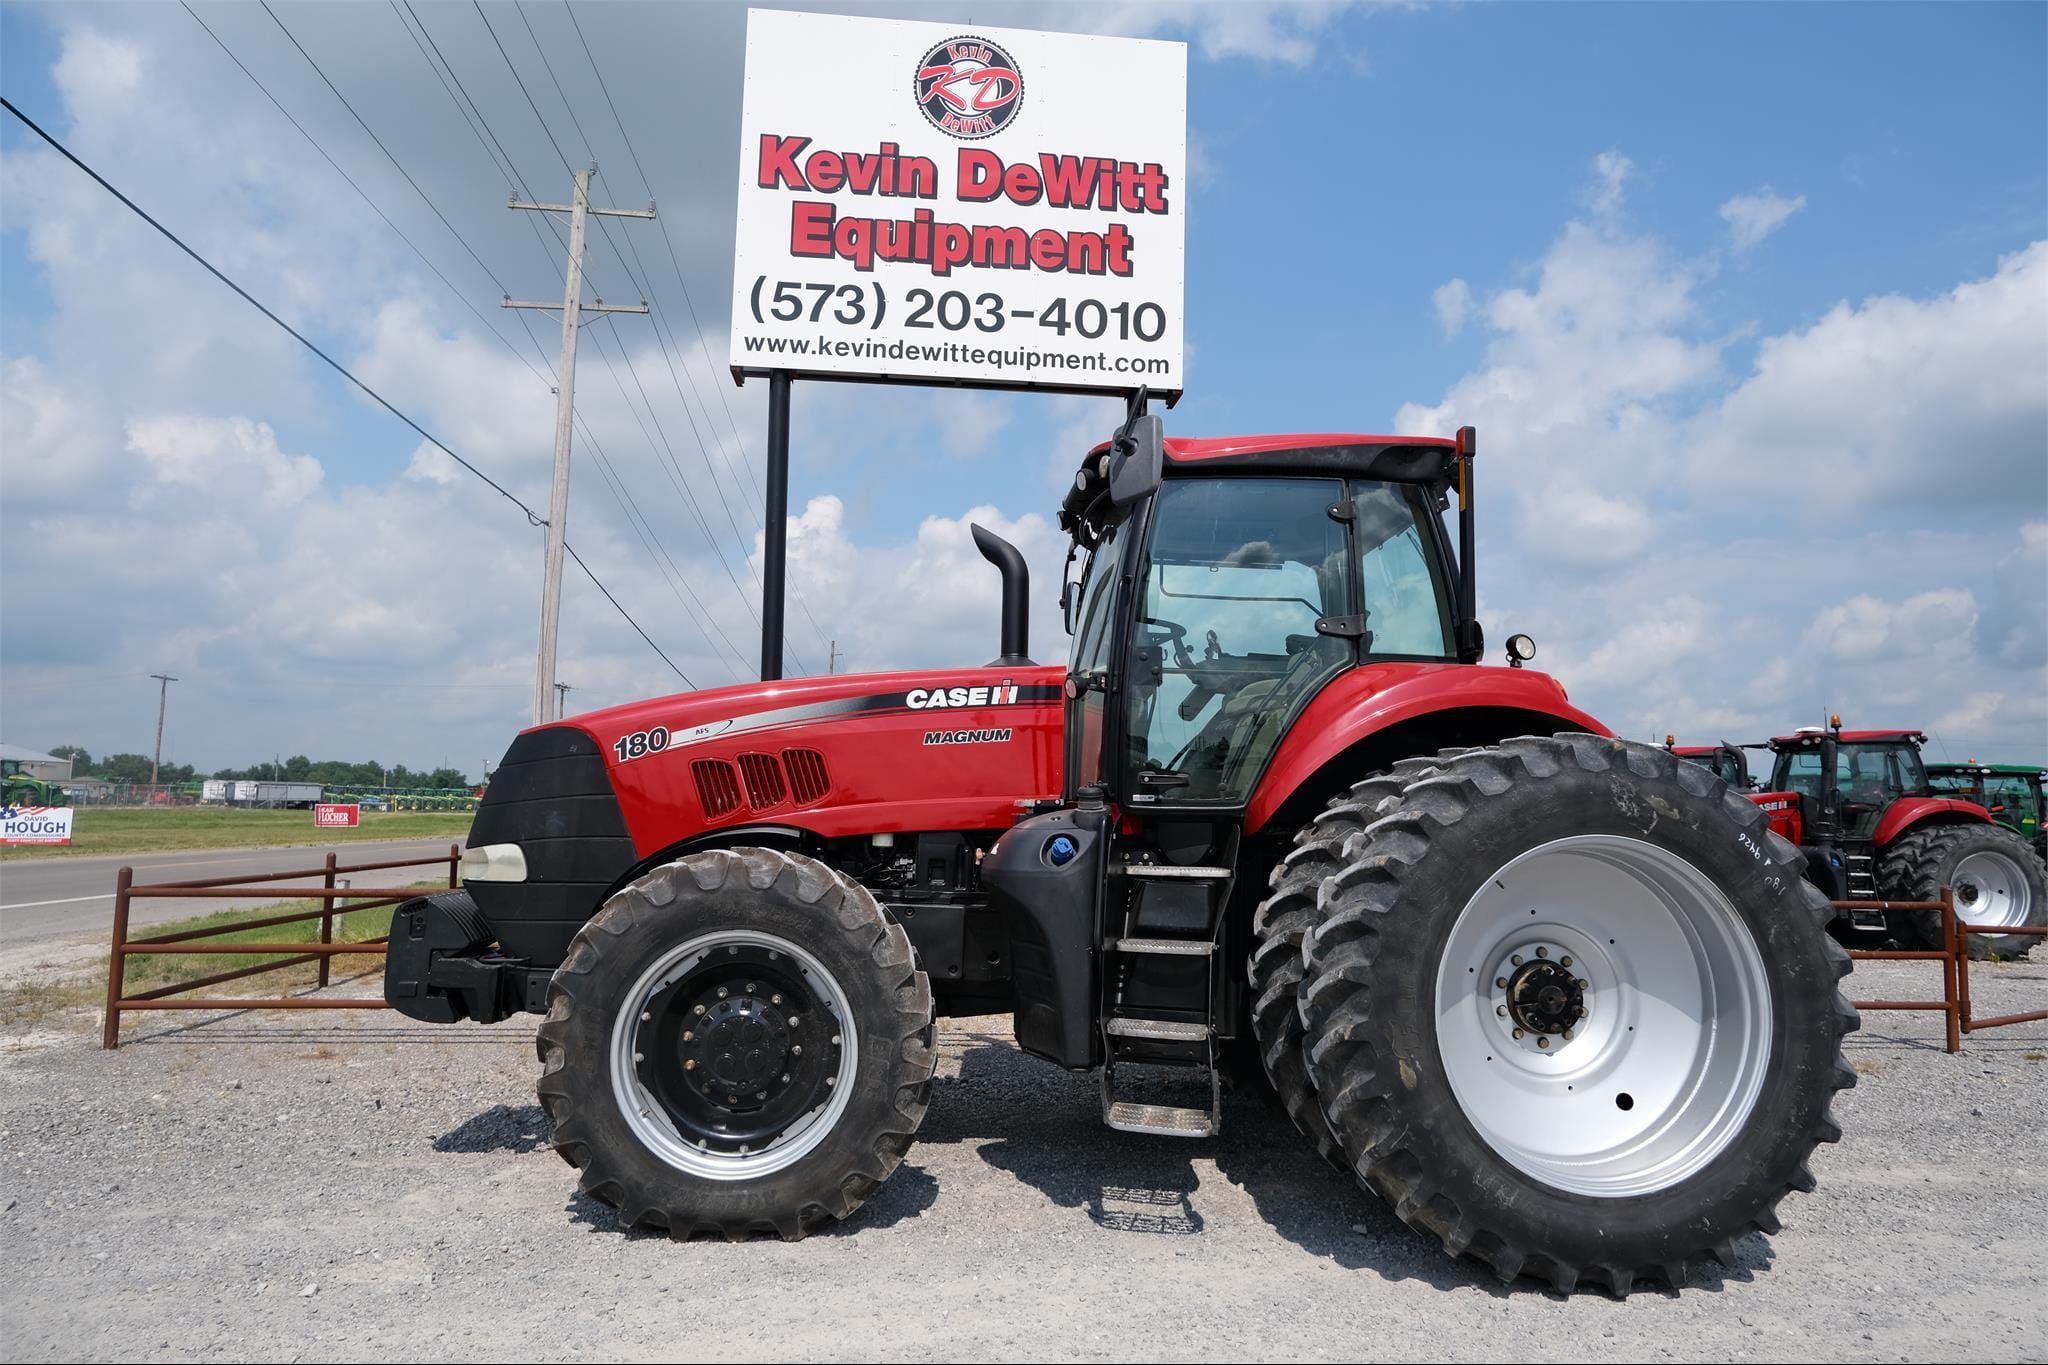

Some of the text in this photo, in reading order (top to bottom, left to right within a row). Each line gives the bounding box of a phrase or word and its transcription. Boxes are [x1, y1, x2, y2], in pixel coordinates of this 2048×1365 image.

[947, 44, 993, 62] Kevin
[918, 64, 1020, 111] KD
[940, 112, 996, 134] DeWitt
[758, 133, 1169, 215] Kevin DeWitt
[790, 200, 1134, 278] Equipment
[750, 275, 1167, 342] (573) 203-4010
[744, 335, 1170, 374] www.kevindewittequipment.com
[906, 687, 989, 709] CASE
[613, 726, 710, 762] 180 AFS
[923, 728, 1013, 746] MAGNUM
[5, 821, 66, 833] HOUGH
